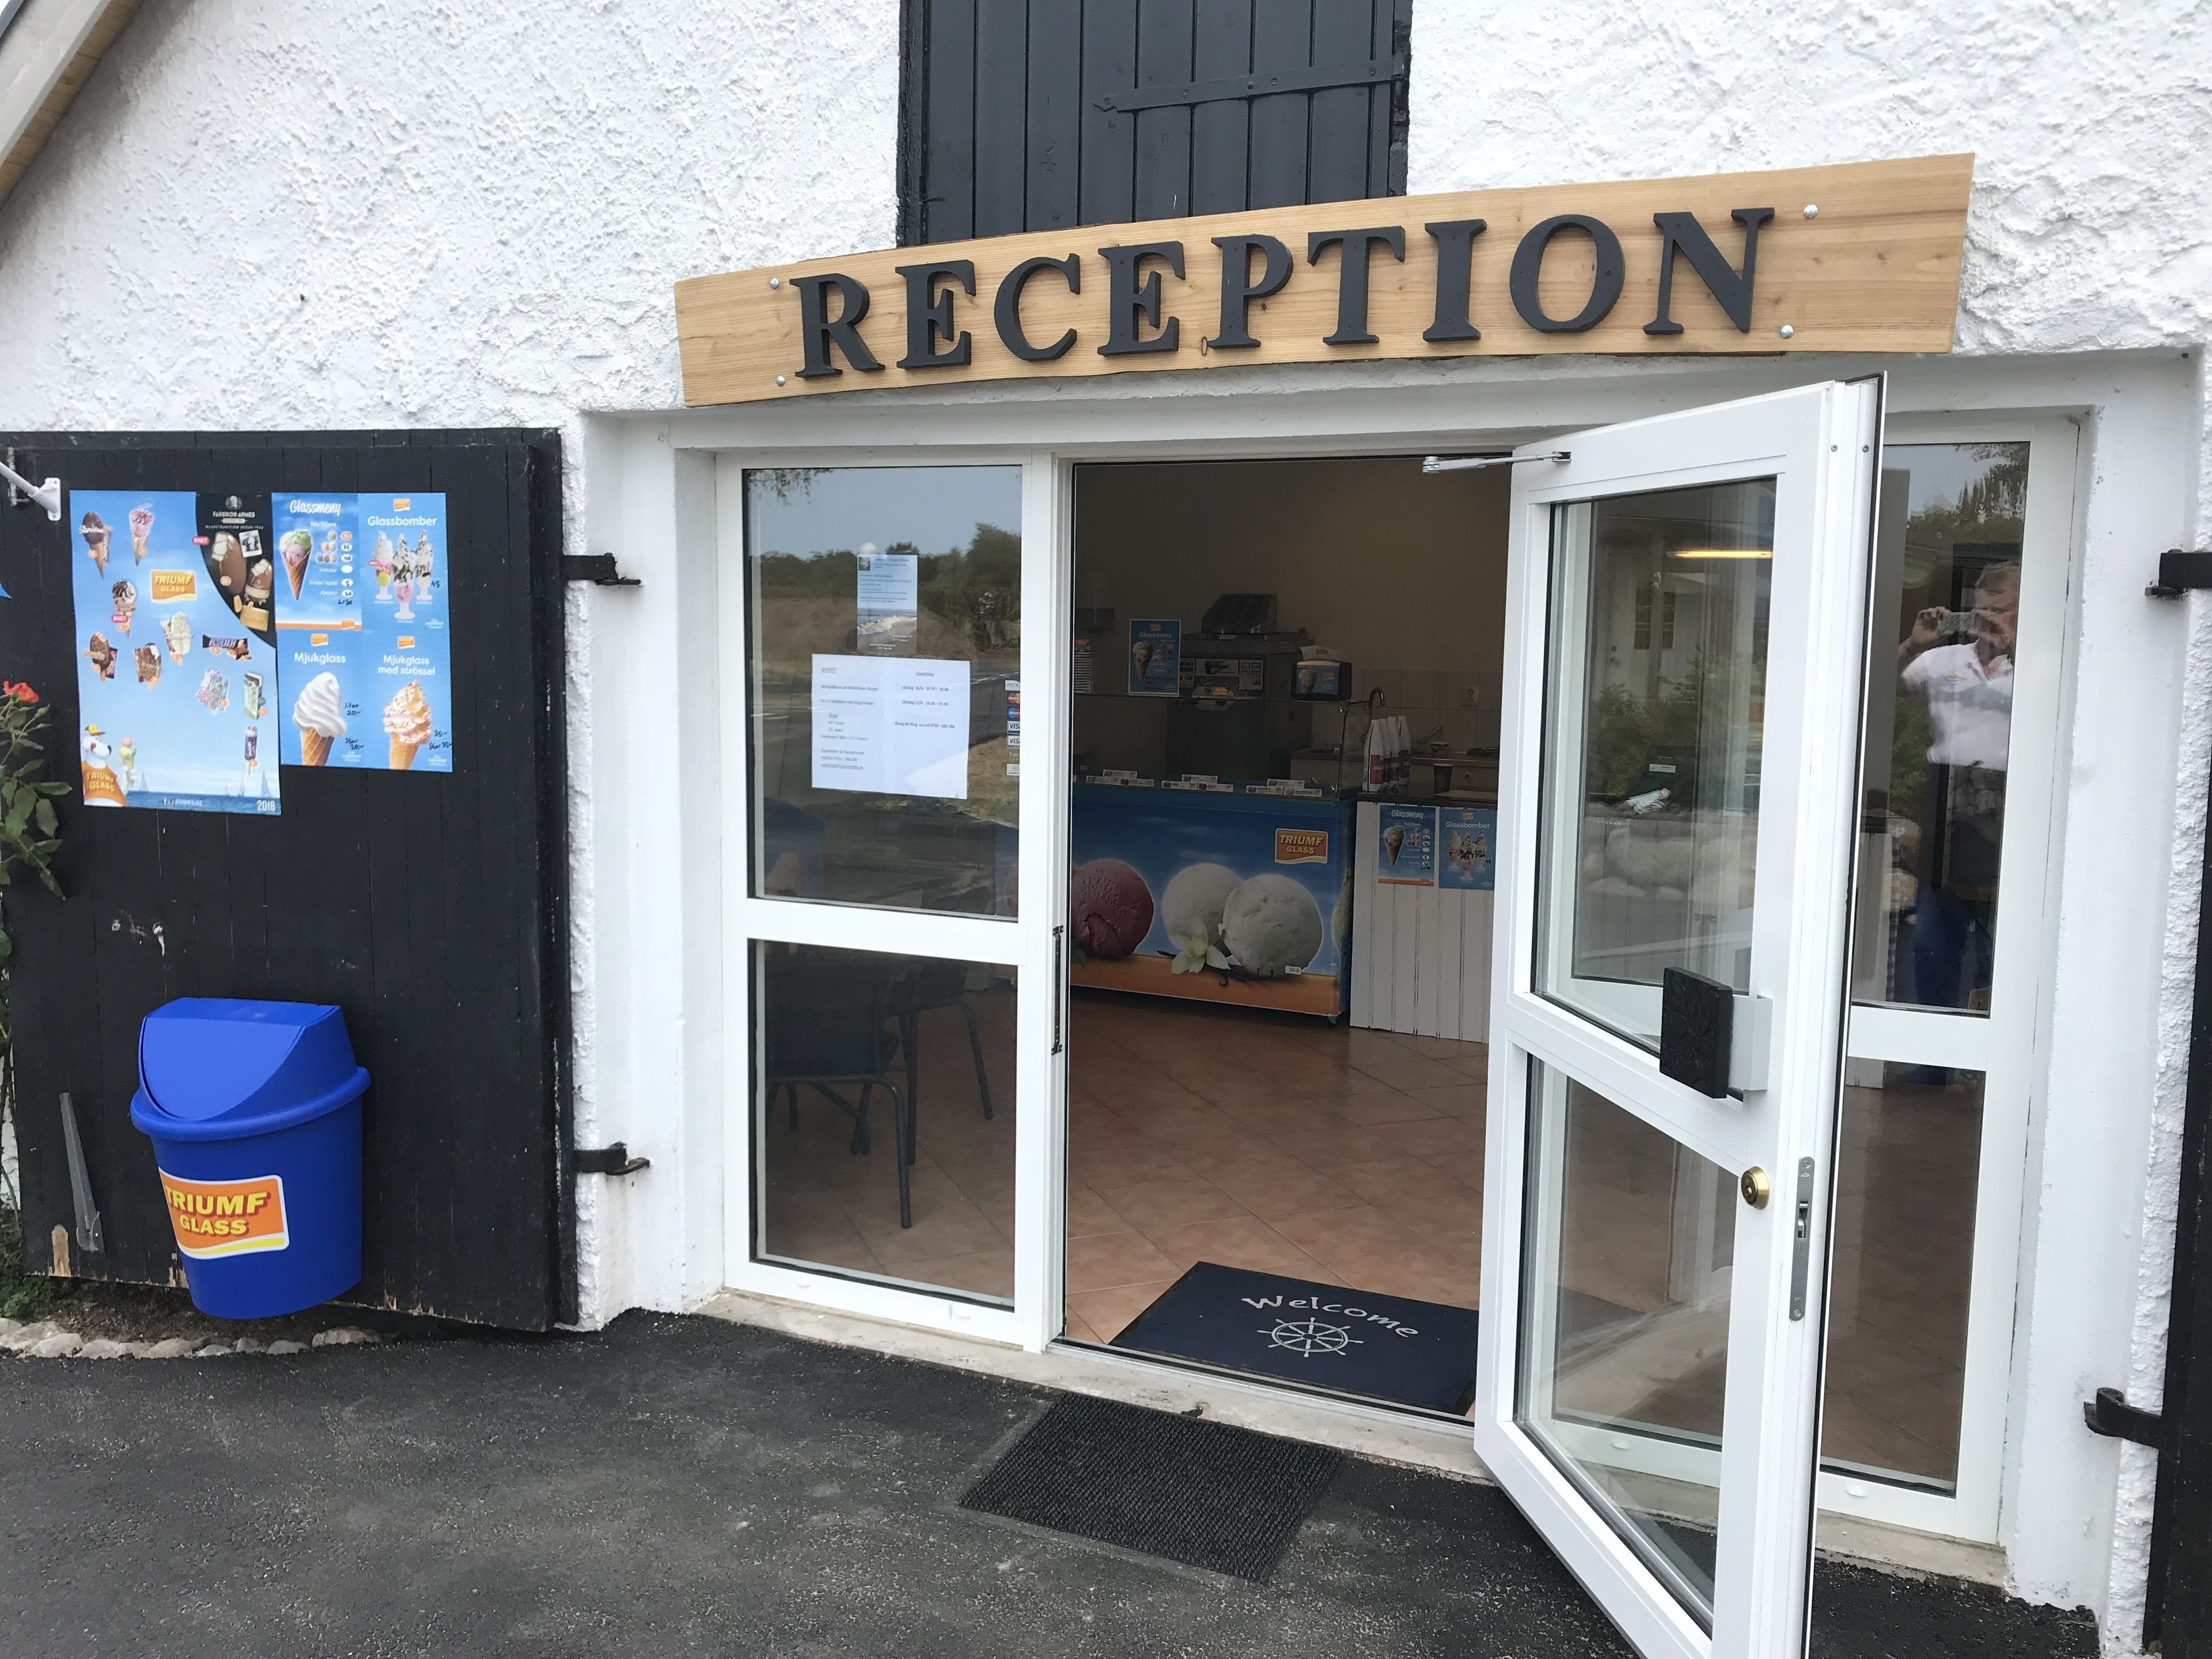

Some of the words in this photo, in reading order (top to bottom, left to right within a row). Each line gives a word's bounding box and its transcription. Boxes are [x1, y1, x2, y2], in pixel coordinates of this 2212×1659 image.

[789, 207, 1775, 378] RECEPTION
[290, 499, 341, 517] Glassmeny
[368, 516, 438, 526] Glassbomber
[154, 575, 192, 585] TRIUMF
[294, 652, 346, 665] Mjukglass
[383, 654, 430, 666] Mjukglass
[378, 666, 399, 674] med
[400, 666, 435, 676] strössel
[89, 781, 115, 791] GLASS
[256, 800, 276, 812] 2018
[1391, 809, 1425, 820] Glassmeny
[1445, 821, 1491, 829] Glassbomber
[1280, 834, 1323, 846] TRIUMF
[1286, 845, 1316, 854] GLASS
[165, 1184, 270, 1217] TRIUMF
[179, 1214, 248, 1236] GLASS
[1240, 1294, 1419, 1338] Welcome
